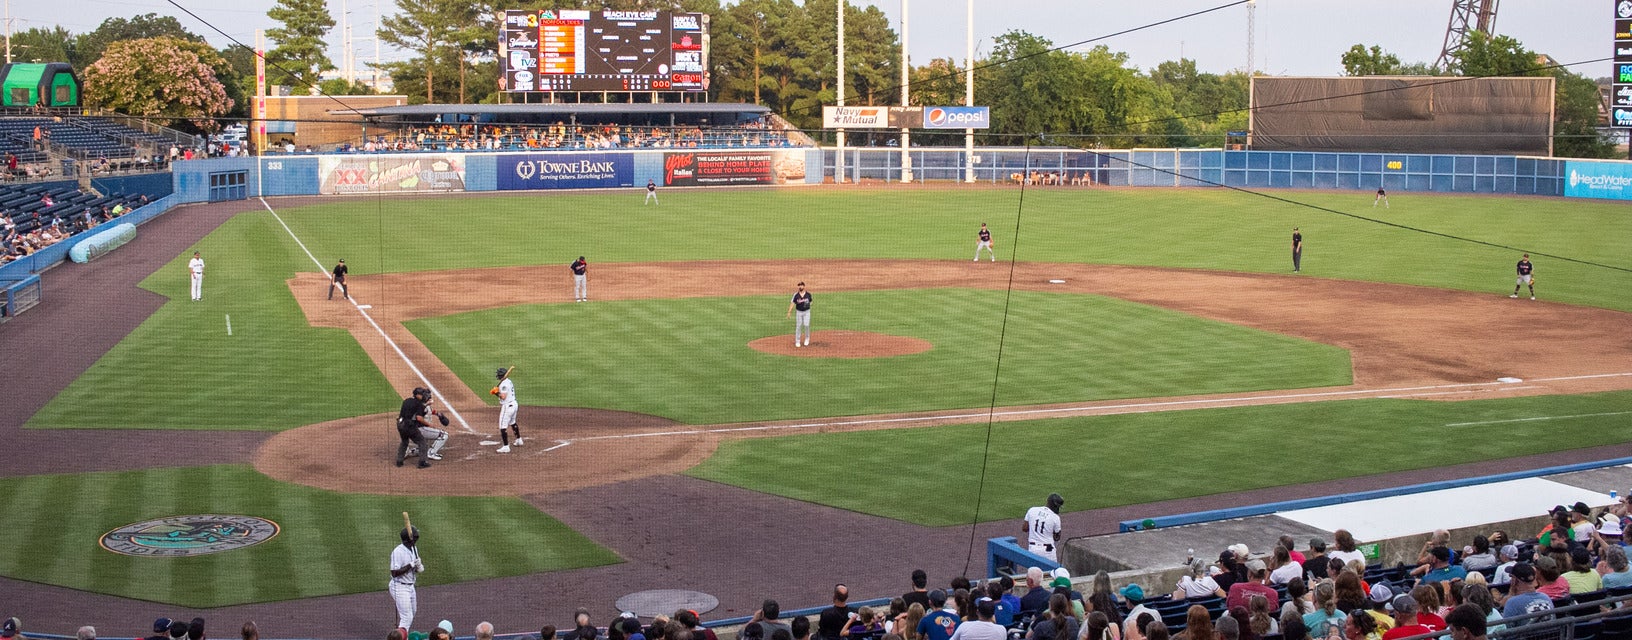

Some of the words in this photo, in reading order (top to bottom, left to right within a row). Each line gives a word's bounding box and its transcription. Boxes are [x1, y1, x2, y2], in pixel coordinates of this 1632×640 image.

[528, 14, 537, 26] 3
[673, 74, 700, 82] Canon
[836, 108, 860, 116] Navy
[948, 111, 984, 123] pepsi
[268, 162, 282, 170] 333
[1387, 161, 1402, 169] 400
[336, 169, 367, 185] XX
[1035, 519, 1045, 534] 11
